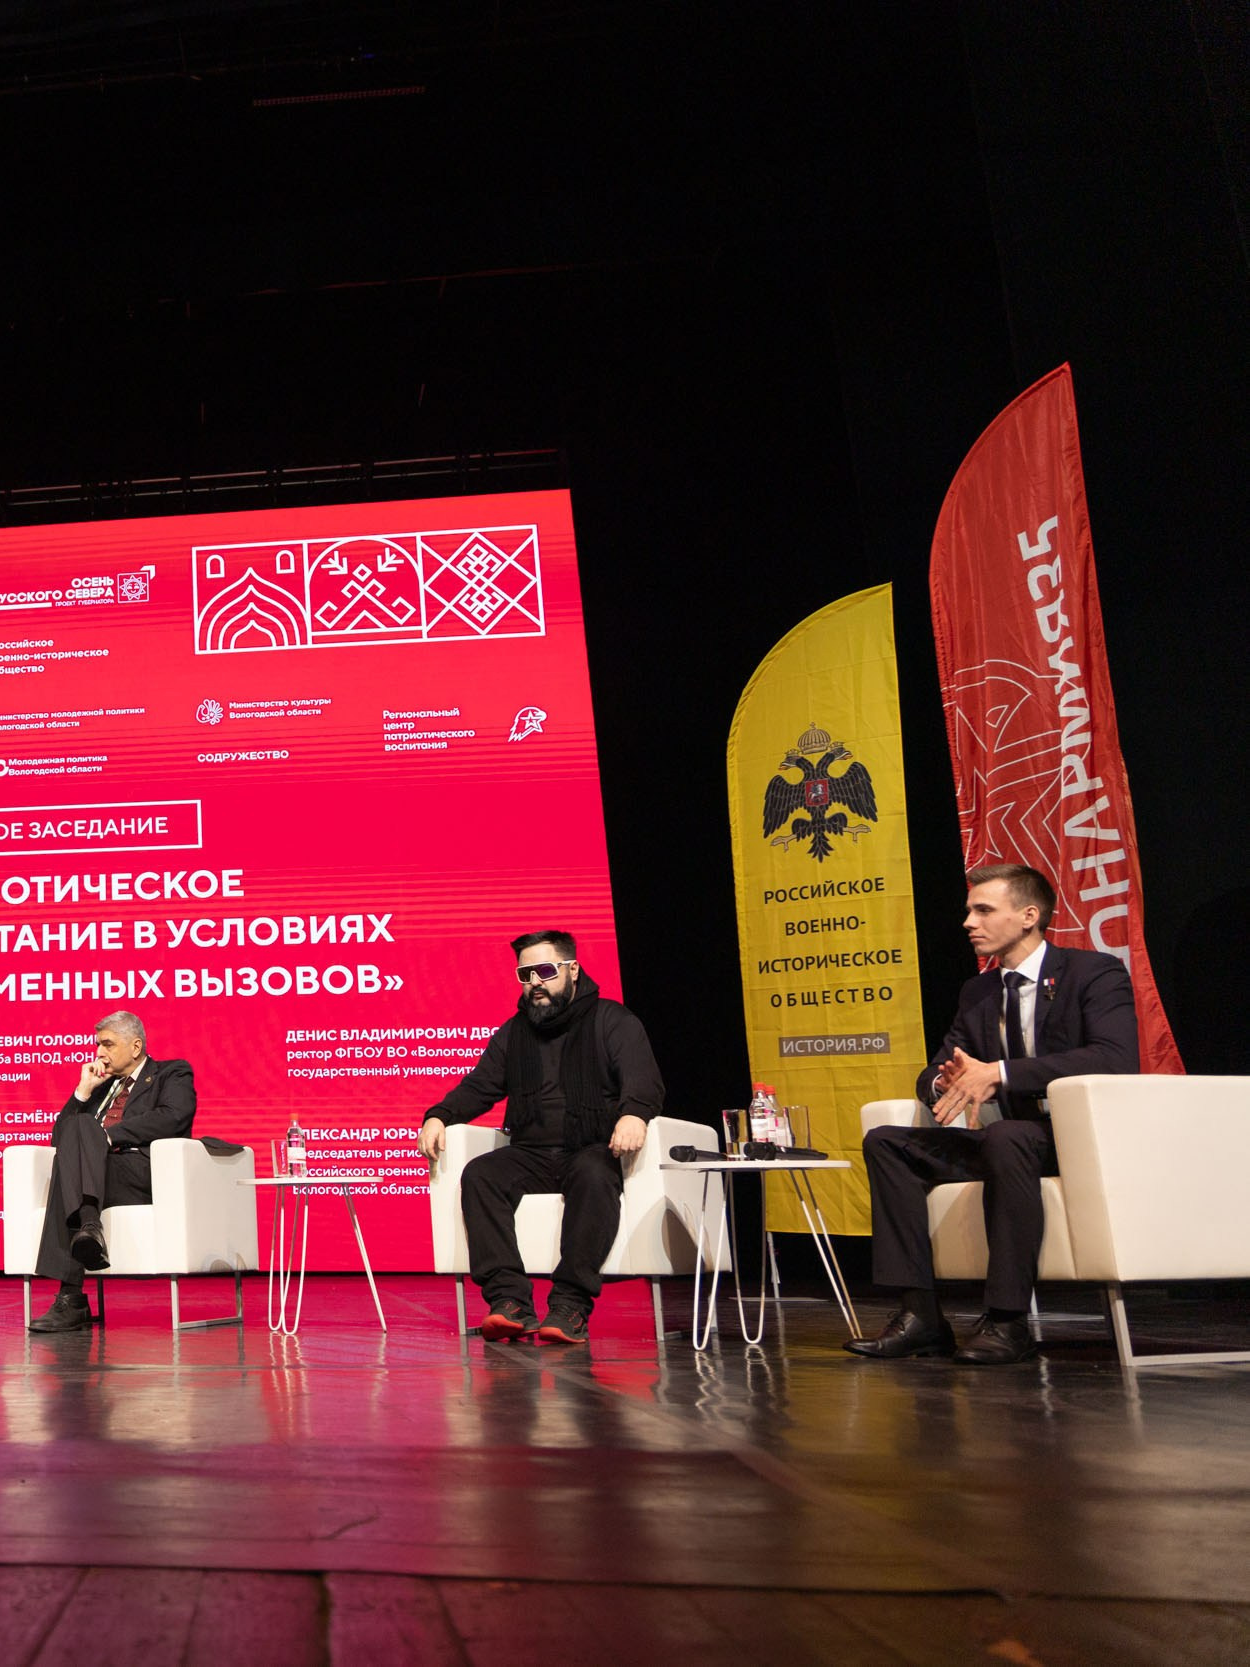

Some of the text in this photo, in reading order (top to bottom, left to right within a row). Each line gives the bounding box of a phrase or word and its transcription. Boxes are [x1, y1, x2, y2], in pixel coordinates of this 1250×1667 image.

[71, 576, 115, 589] ОСЕНЬ
[64, 586, 115, 600] СЕВЕРА
[228, 698, 332, 709] Министерство культуры
[50, 708, 104, 718] молодежной
[229, 708, 322, 719] Вологодской области
[382, 707, 460, 720] Региональный
[45, 720, 80, 729] области
[383, 721, 415, 731] центр
[383, 729, 476, 742] патриотического
[384, 741, 448, 752] воспитания
[8, 755, 108, 766] Молодежная политика
[197, 749, 289, 763] СОДРУЖЕСТВО
[8, 765, 103, 776] Вологодской области
[28, 816, 169, 840] ЗАСЕДАНИЕ
[764, 877, 885, 904] РОССИЙСКОЕ
[133, 920, 158, 949] В
[165, 913, 395, 949] УСЛОВИЯХ
[785, 916, 866, 936] ВОЕННО-
[758, 949, 903, 974] ИСТОРИЧЕСКОЕ
[174, 964, 404, 998] ВЫЗОВОВ»
[771, 986, 894, 1007] ОБЩЕСТВО
[285, 1029, 338, 1044] ДЕНИС
[340, 1027, 468, 1042] ВЛАДИМИРОВИЧ
[782, 1036, 886, 1054] ИСТОРИЯ.РФ
[14, 1052, 63, 1065] ВВПОД
[286, 1050, 333, 1062] ректор
[334, 1046, 384, 1059] ФГБОУ
[386, 1046, 408, 1058] ВО
[287, 1064, 401, 1080] государственный
[302, 1128, 381, 1142] ЛЕКСАНДР
[306, 1148, 383, 1160] едседатель
[292, 1183, 378, 1197] Вологодской
